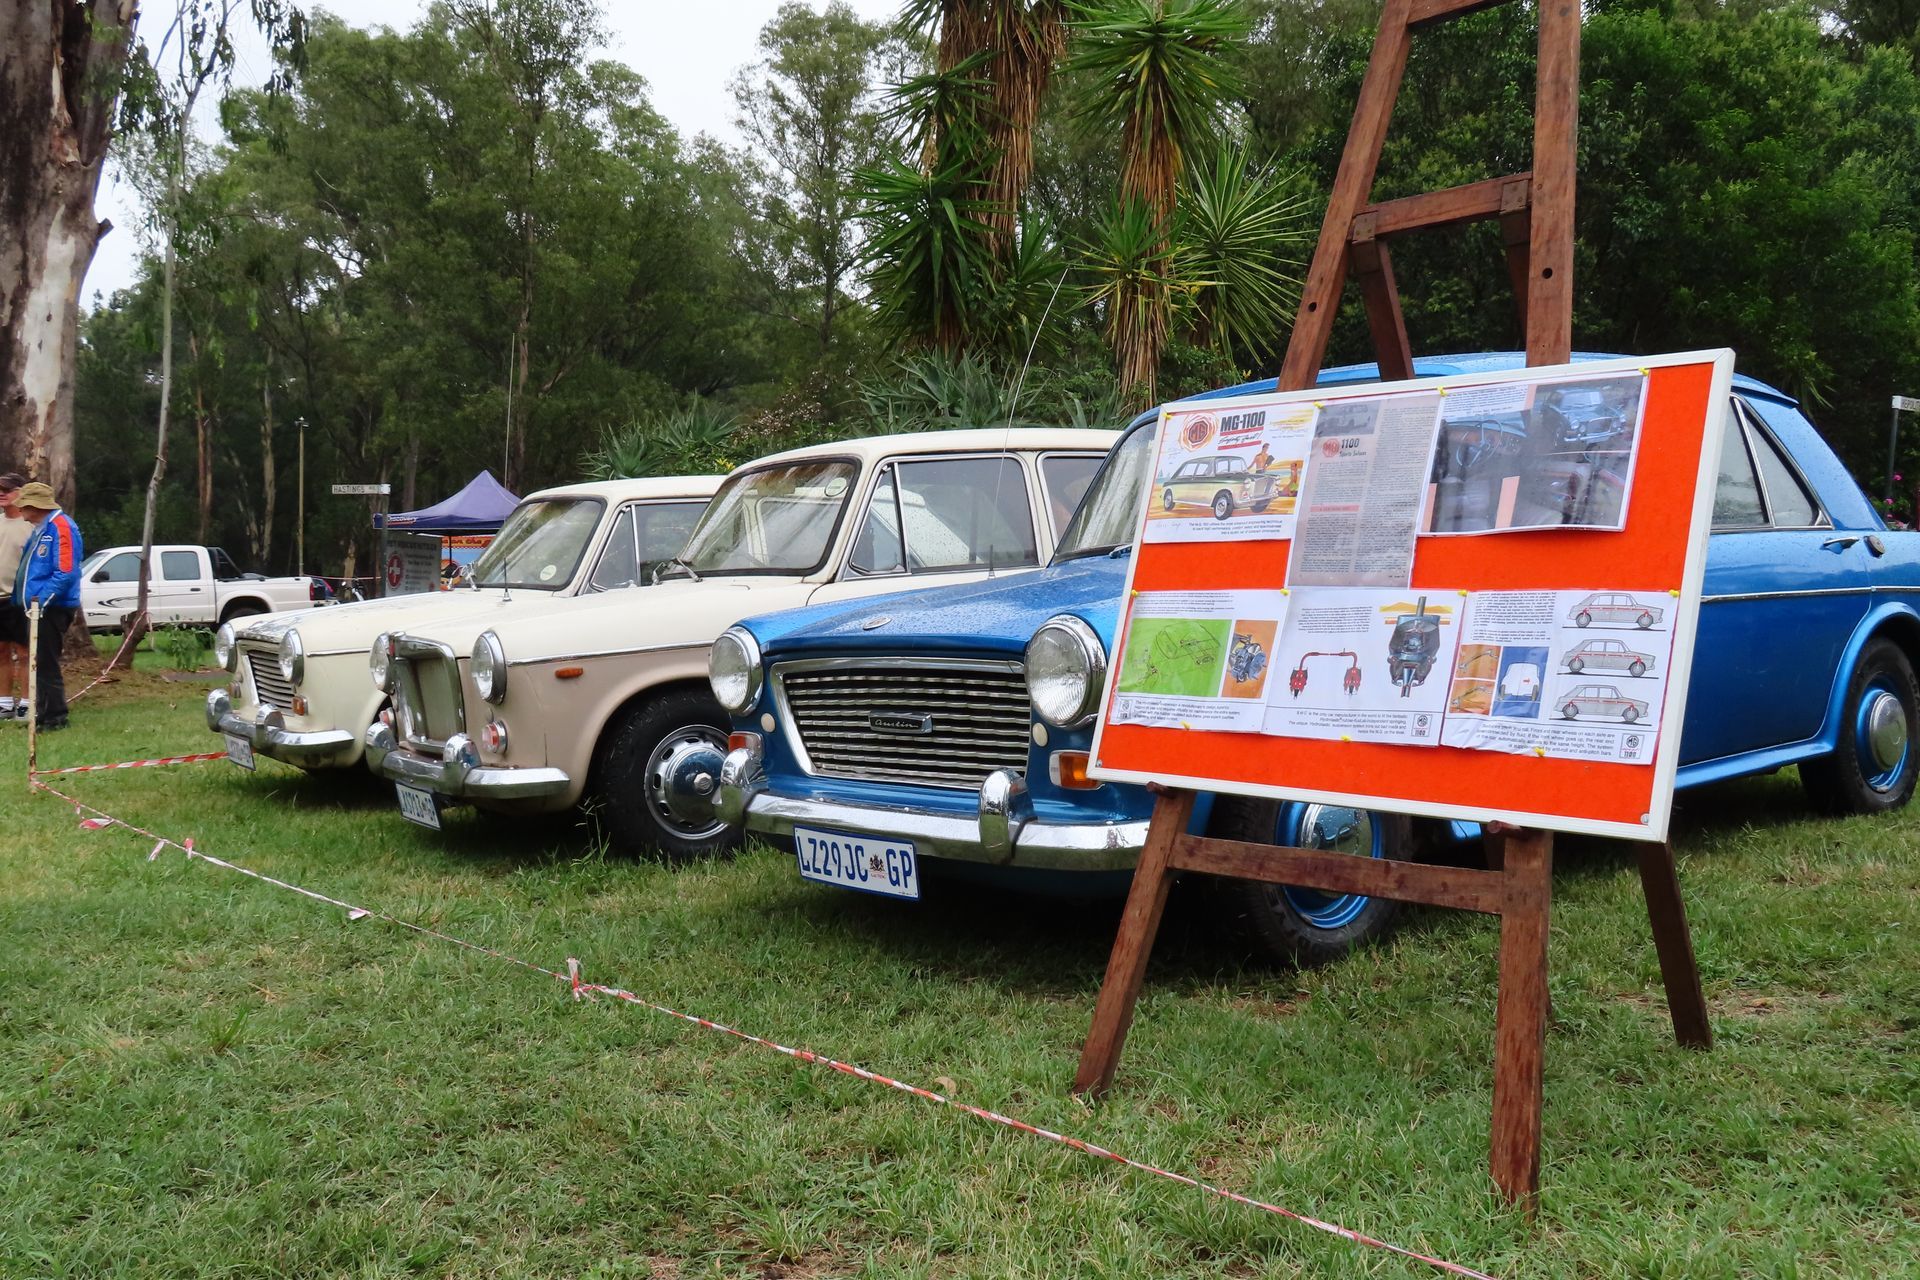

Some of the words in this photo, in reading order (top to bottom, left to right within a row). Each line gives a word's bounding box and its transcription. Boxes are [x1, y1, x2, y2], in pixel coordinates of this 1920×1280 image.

[1341, 438, 1360, 449] 1100
[796, 836, 868, 882] LZ29JC
[886, 848, 913, 888] GP
